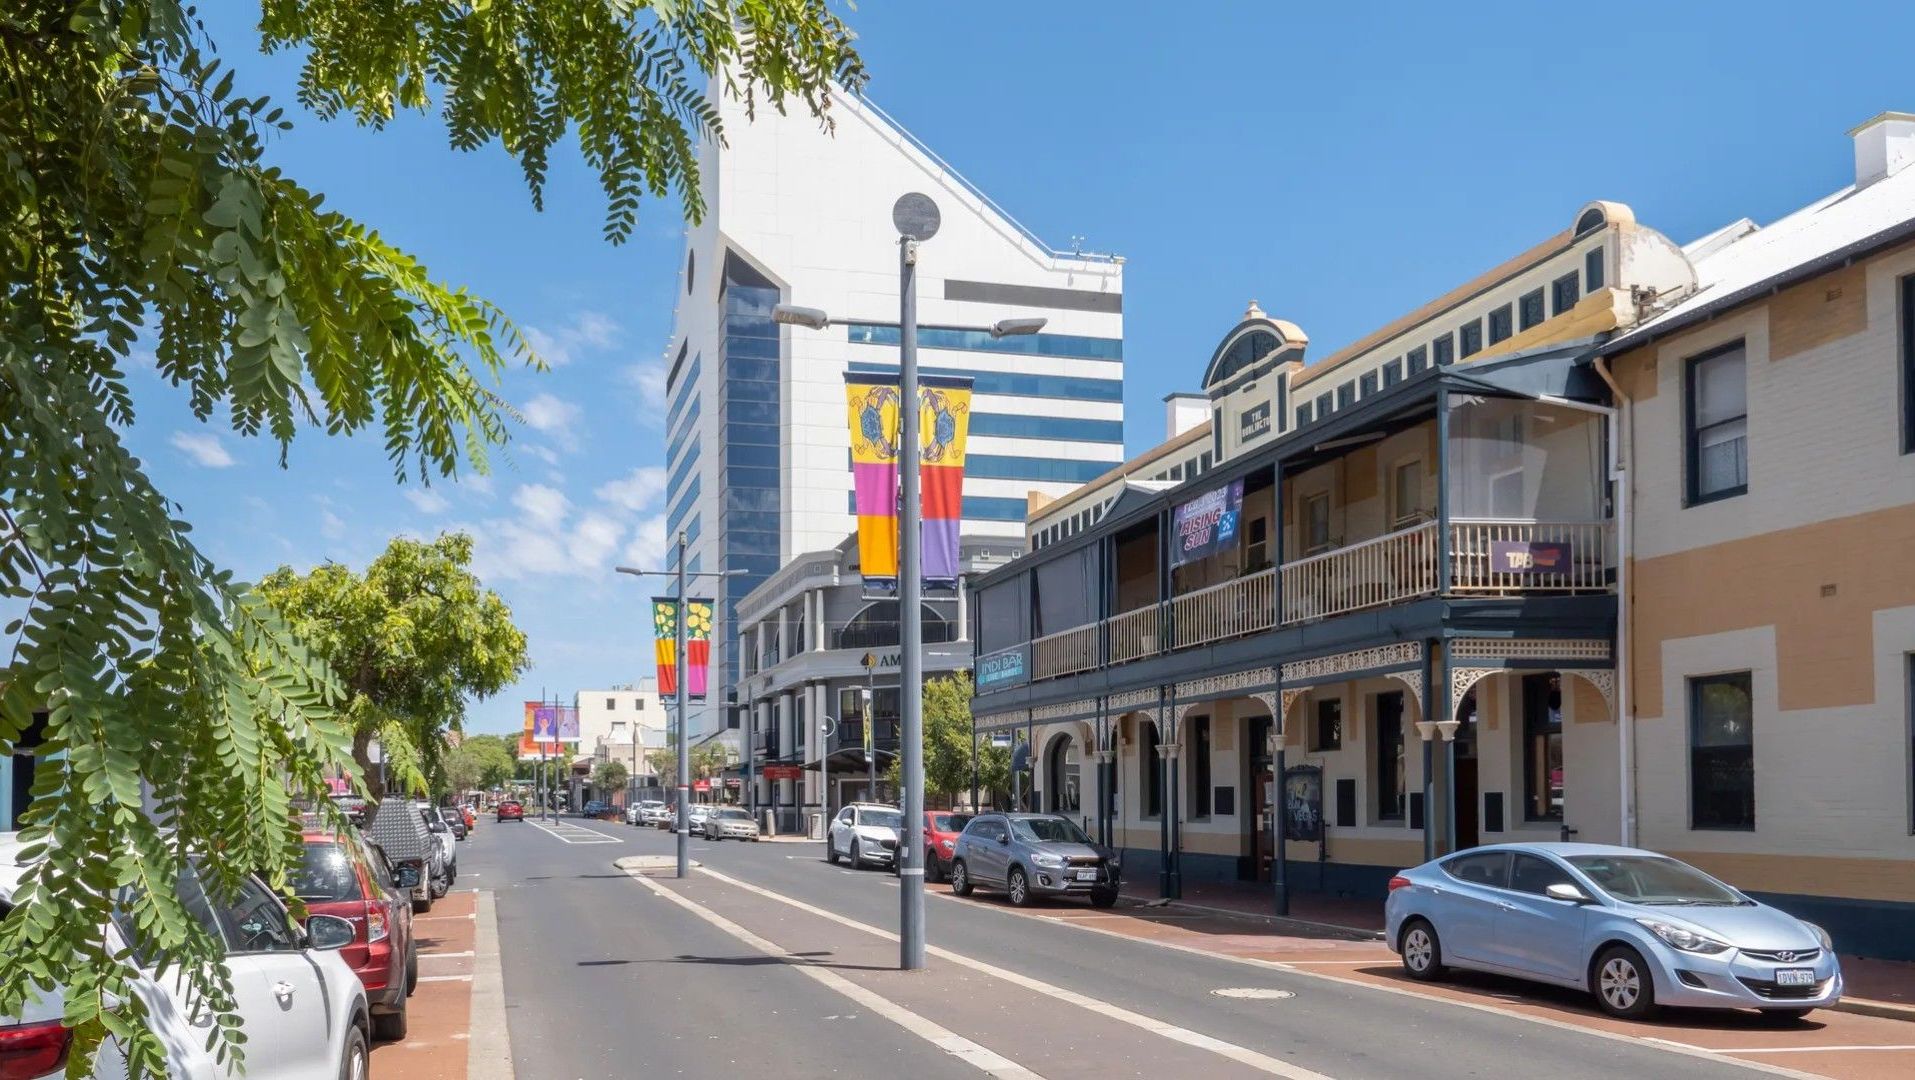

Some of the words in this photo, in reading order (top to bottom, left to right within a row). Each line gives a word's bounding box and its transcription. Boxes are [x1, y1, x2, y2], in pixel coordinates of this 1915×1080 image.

[1251, 409, 1262, 423] THE
[1180, 507, 1222, 536] RISING
[1184, 527, 1211, 551] SUN
[1506, 552, 1533, 569] TAB
[982, 658, 1000, 674] INDI
[1002, 653, 1023, 669] BAR
